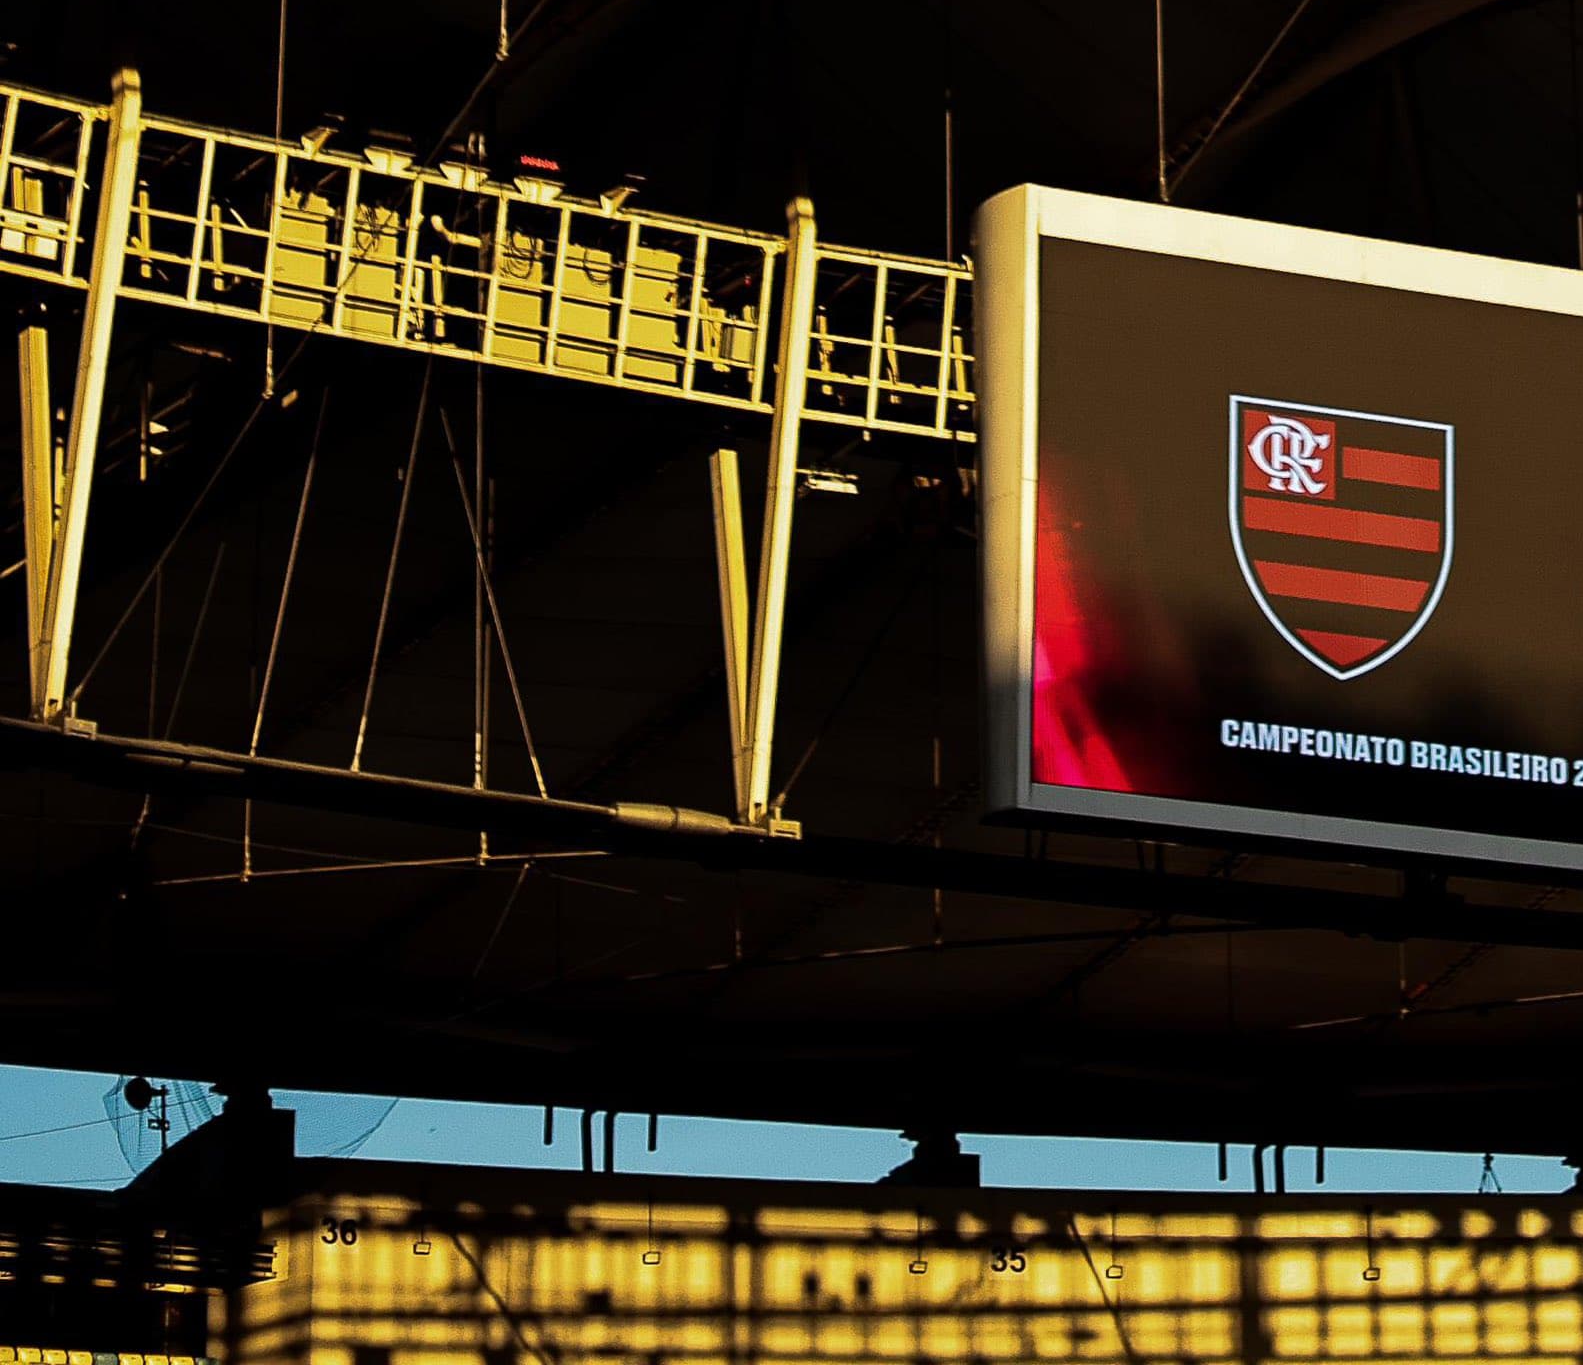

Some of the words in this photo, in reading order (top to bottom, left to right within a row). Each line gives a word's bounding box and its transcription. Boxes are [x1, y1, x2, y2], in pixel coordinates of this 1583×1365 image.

[1220, 718, 1405, 766] CAMPEONATO
[1410, 740, 1569, 785] BRASILEIRO
[321, 1217, 358, 1246] 36
[991, 1247, 1026, 1273] 35
